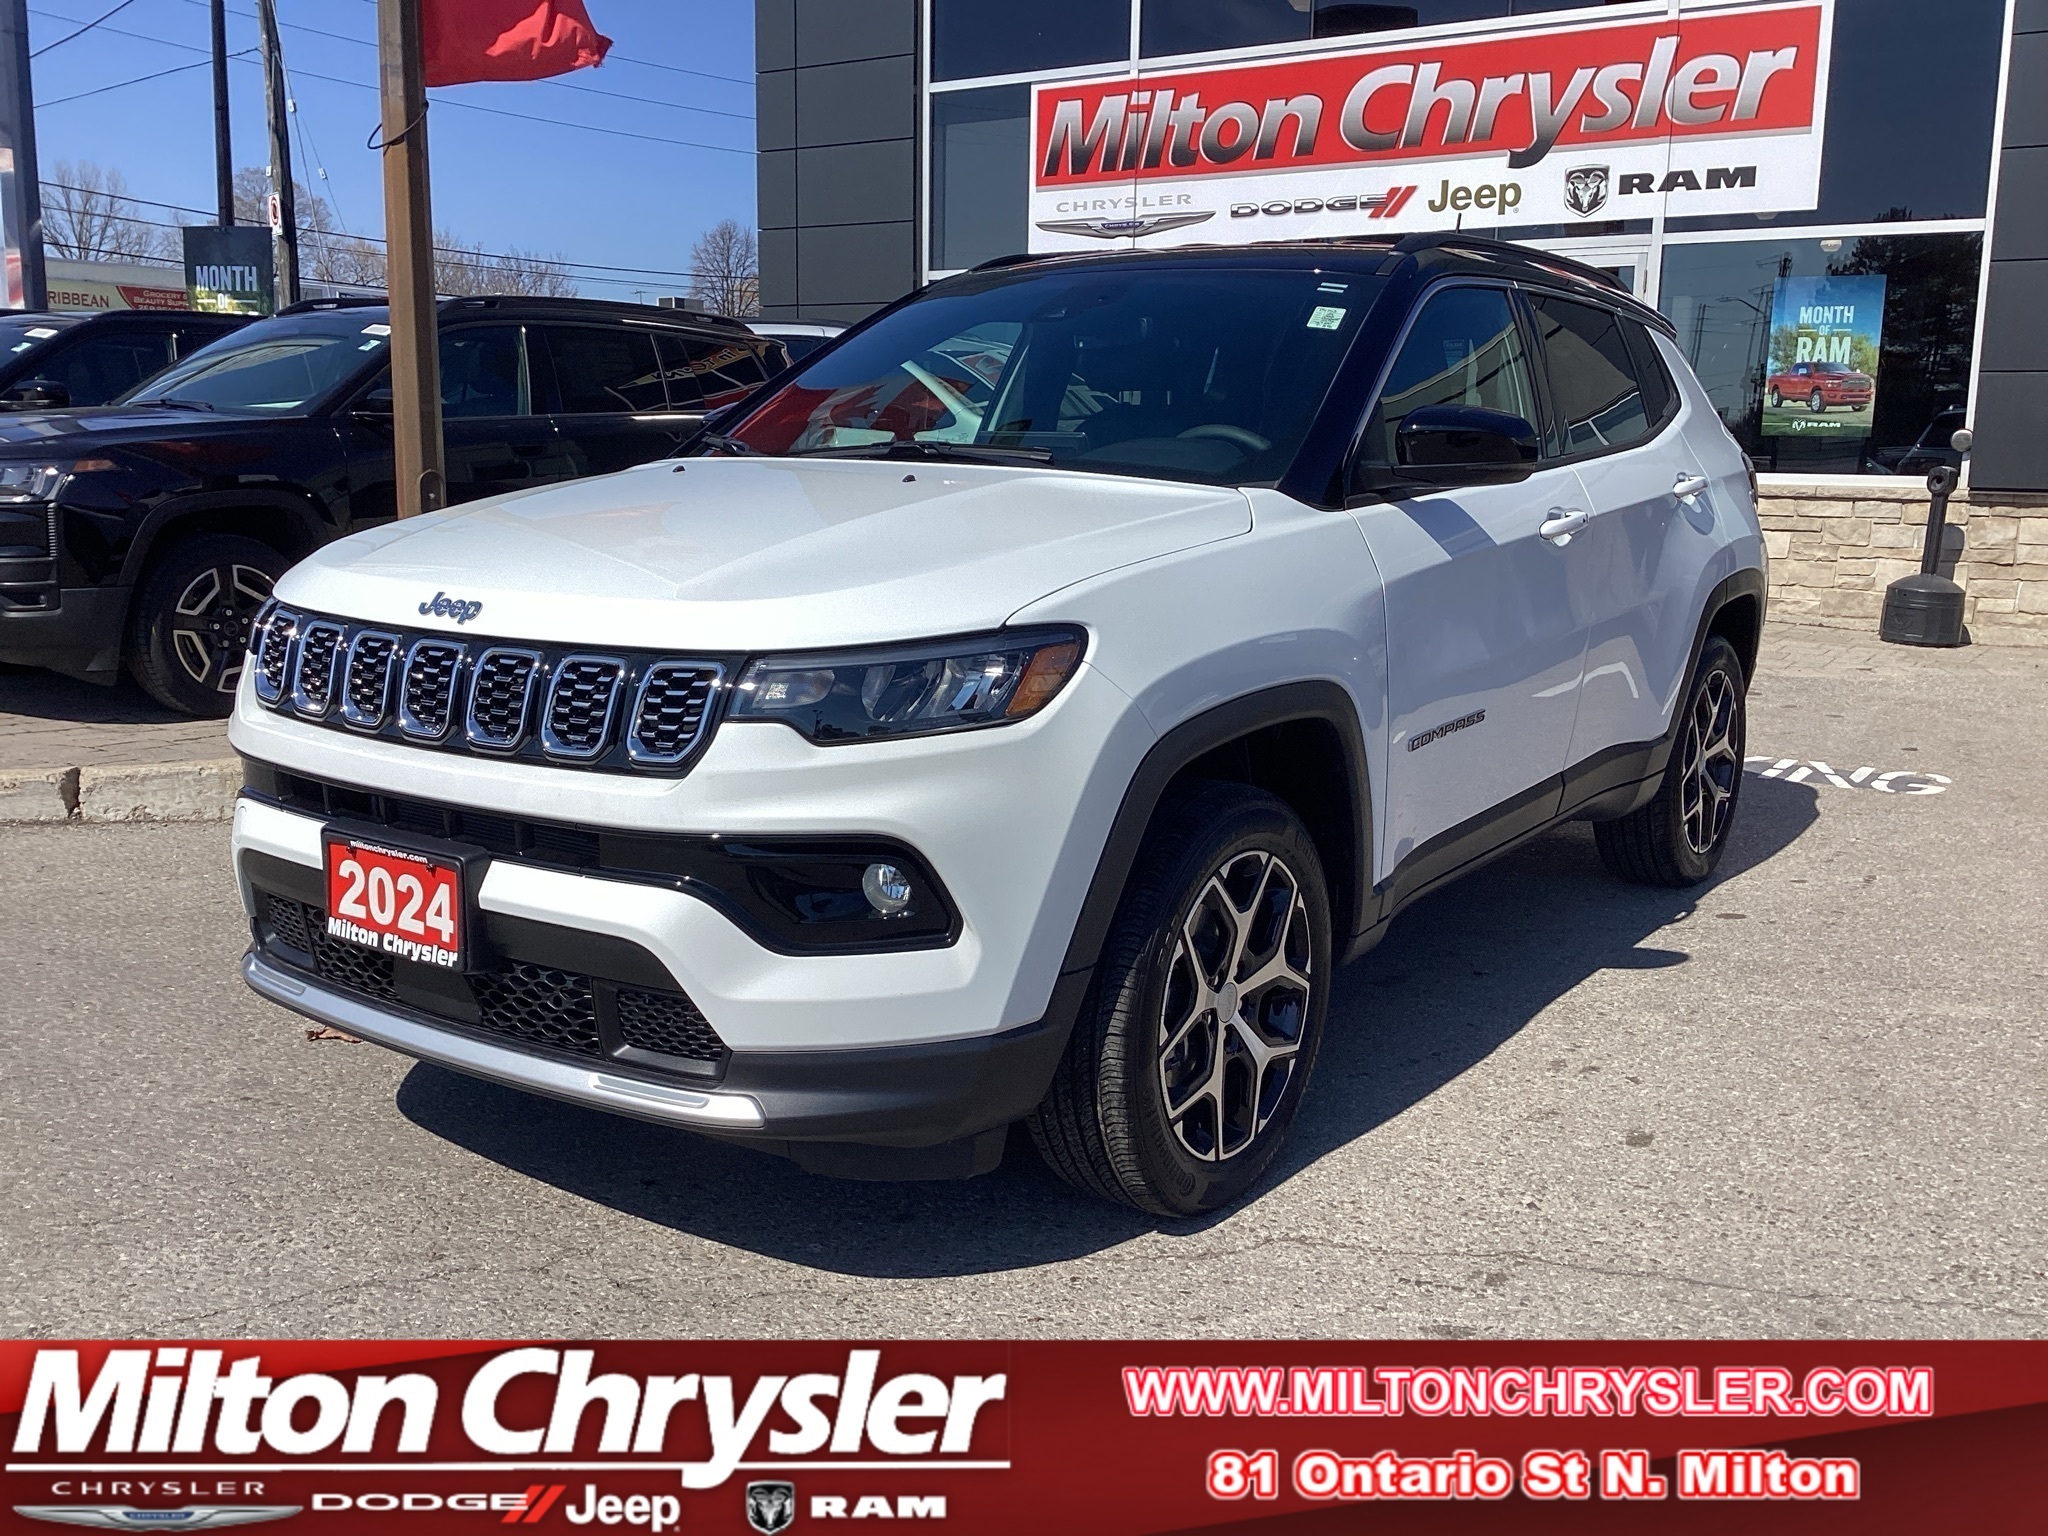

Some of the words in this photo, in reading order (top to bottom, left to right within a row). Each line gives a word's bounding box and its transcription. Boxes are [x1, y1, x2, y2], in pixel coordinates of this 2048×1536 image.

[1041, 88, 1325, 178] Milton
[1339, 34, 1798, 170] Chrysler
[1618, 165, 1757, 195] RAM
[1056, 194, 1192, 213] CHRYSLER
[1230, 193, 1388, 218] DODGE
[1428, 180, 1522, 215] Jeep
[195, 265, 258, 292] MONTH
[1800, 305, 1855, 324] MONTH
[1818, 325, 1831, 335] OF
[1796, 337, 1851, 364] RAM
[418, 591, 483, 625] Jeep
[1407, 708, 1486, 752] COMPASS
[350, 840, 428, 864] miltonchrysler.com
[338, 859, 454, 944] 2024
[327, 916, 378, 947] Milton
[383, 933, 458, 967] Chrysler
